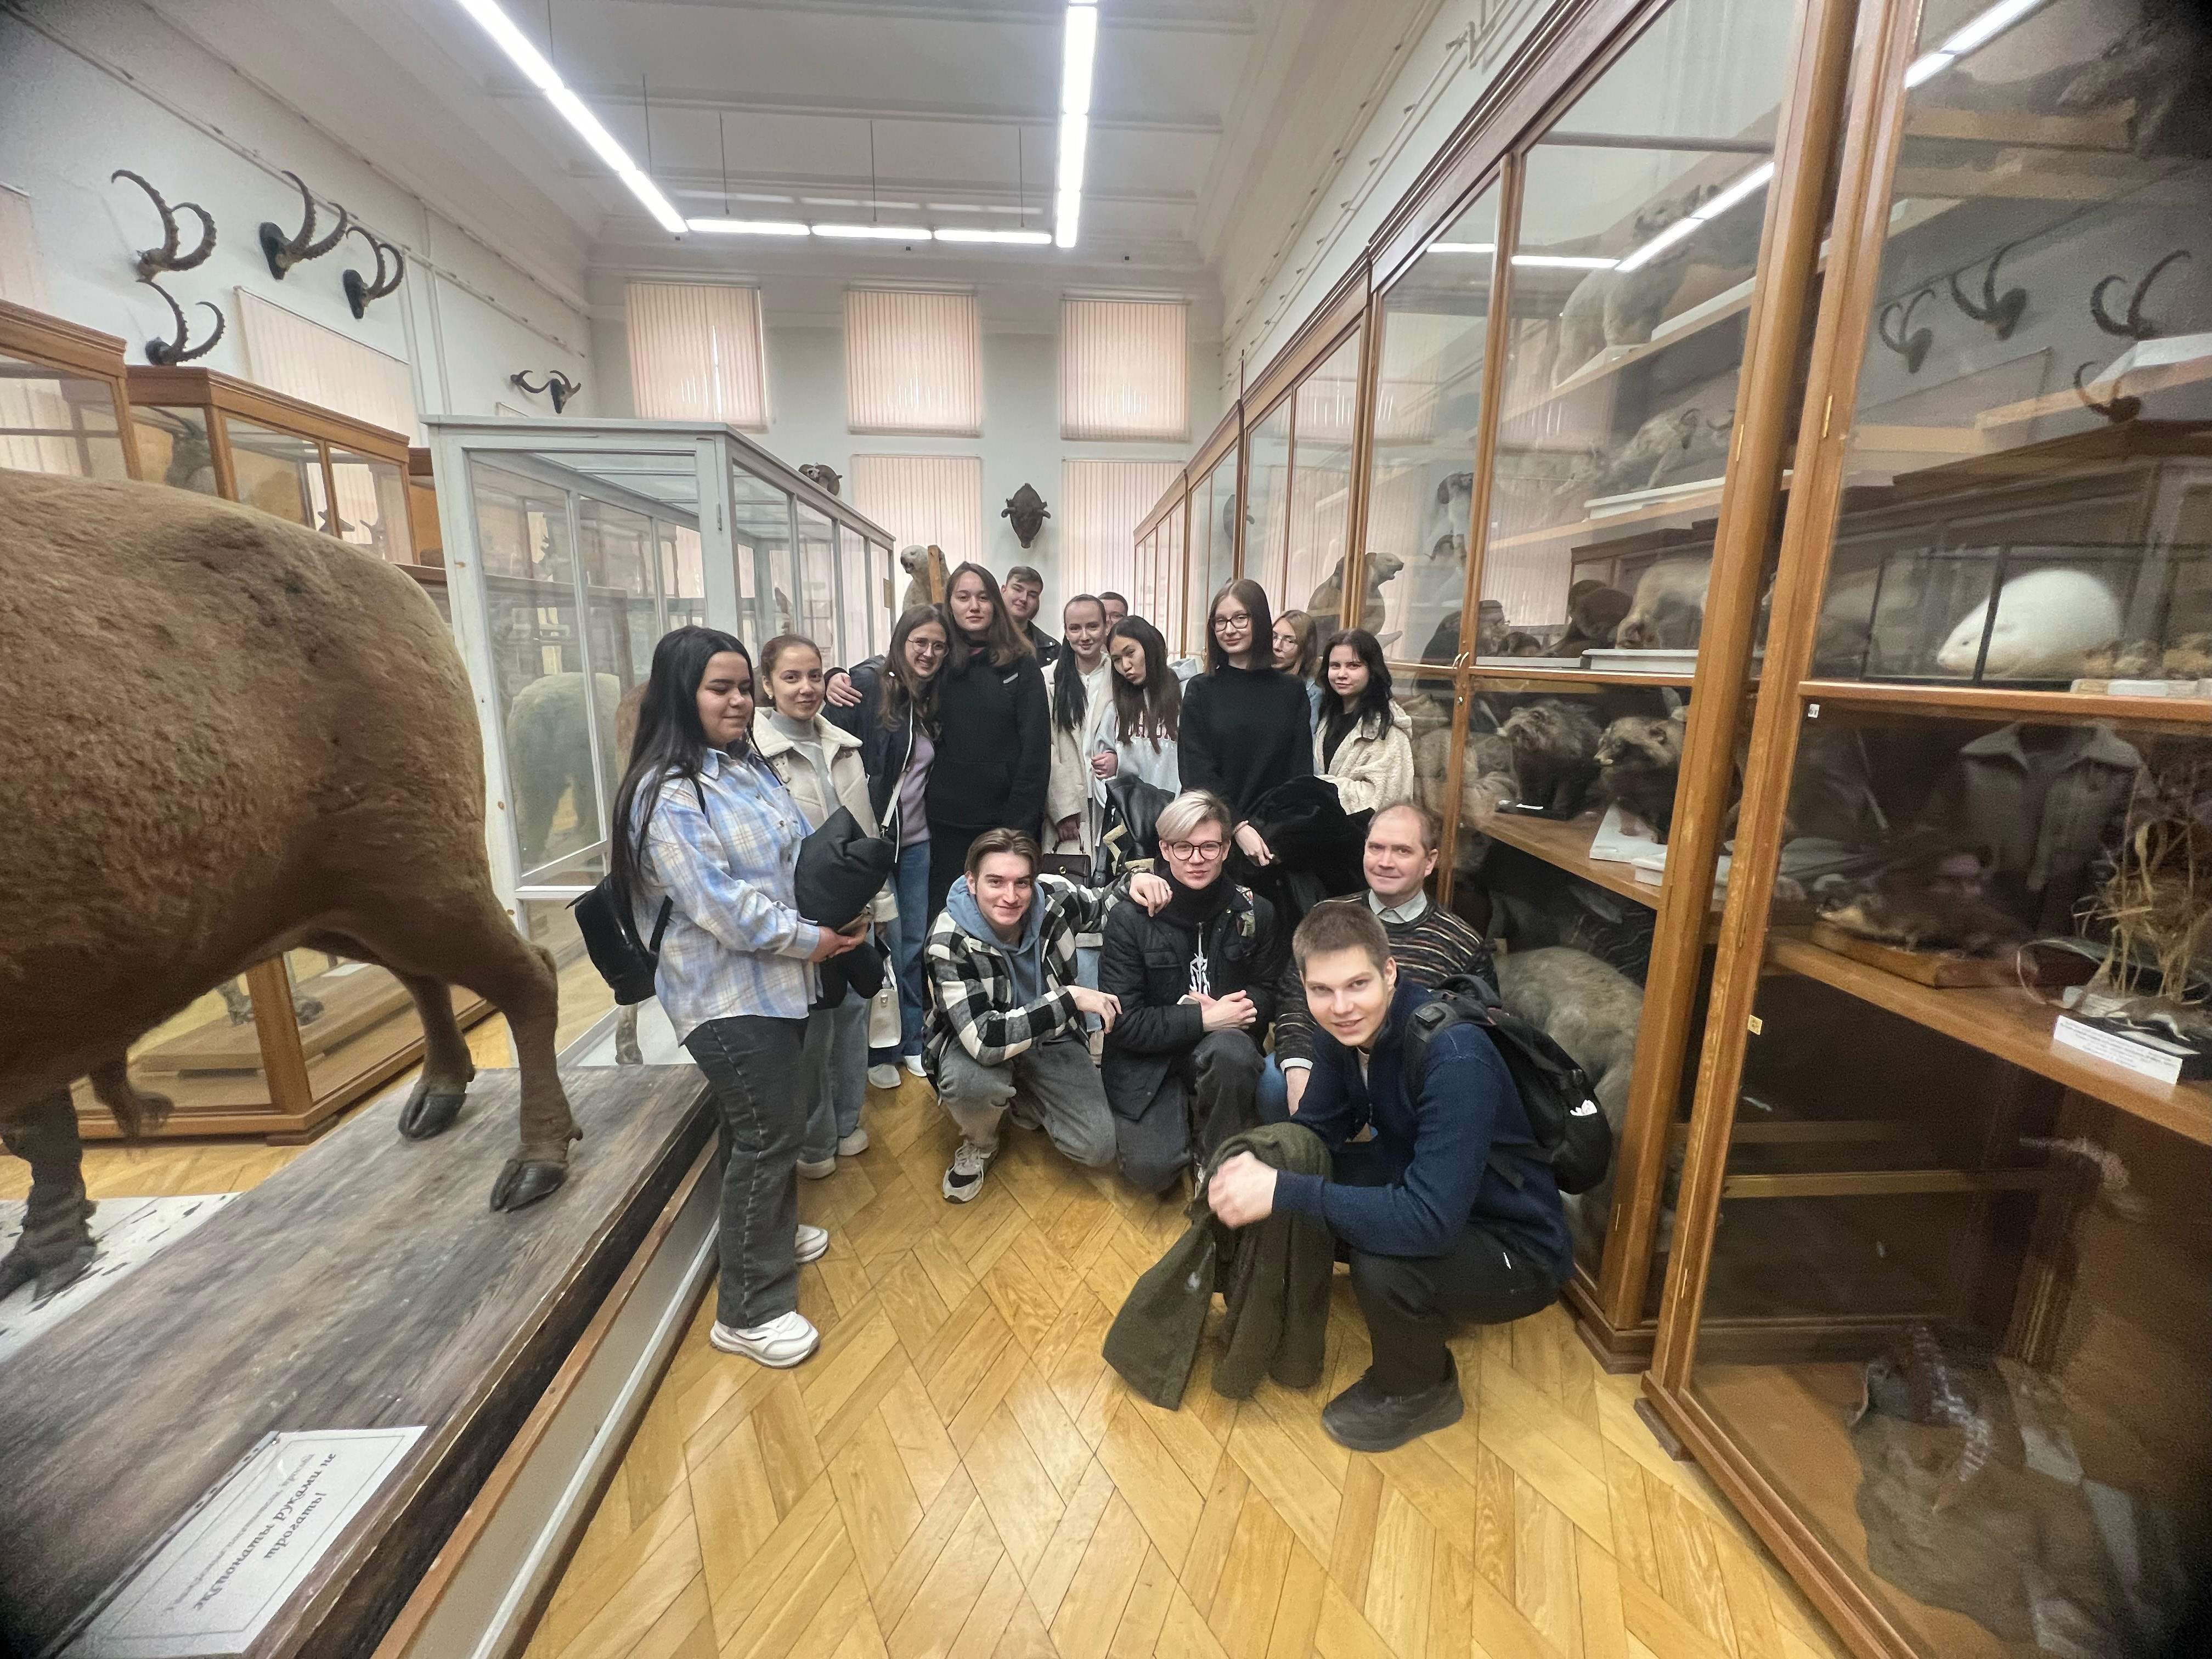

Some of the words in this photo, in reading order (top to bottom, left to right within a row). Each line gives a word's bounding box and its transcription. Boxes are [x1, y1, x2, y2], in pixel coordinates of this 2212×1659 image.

[193, 1523, 275, 1611] экспонаты
[272, 1470, 322, 1521] руками
[319, 1453, 336, 1468] не
[263, 1492, 327, 1559] трогать!
